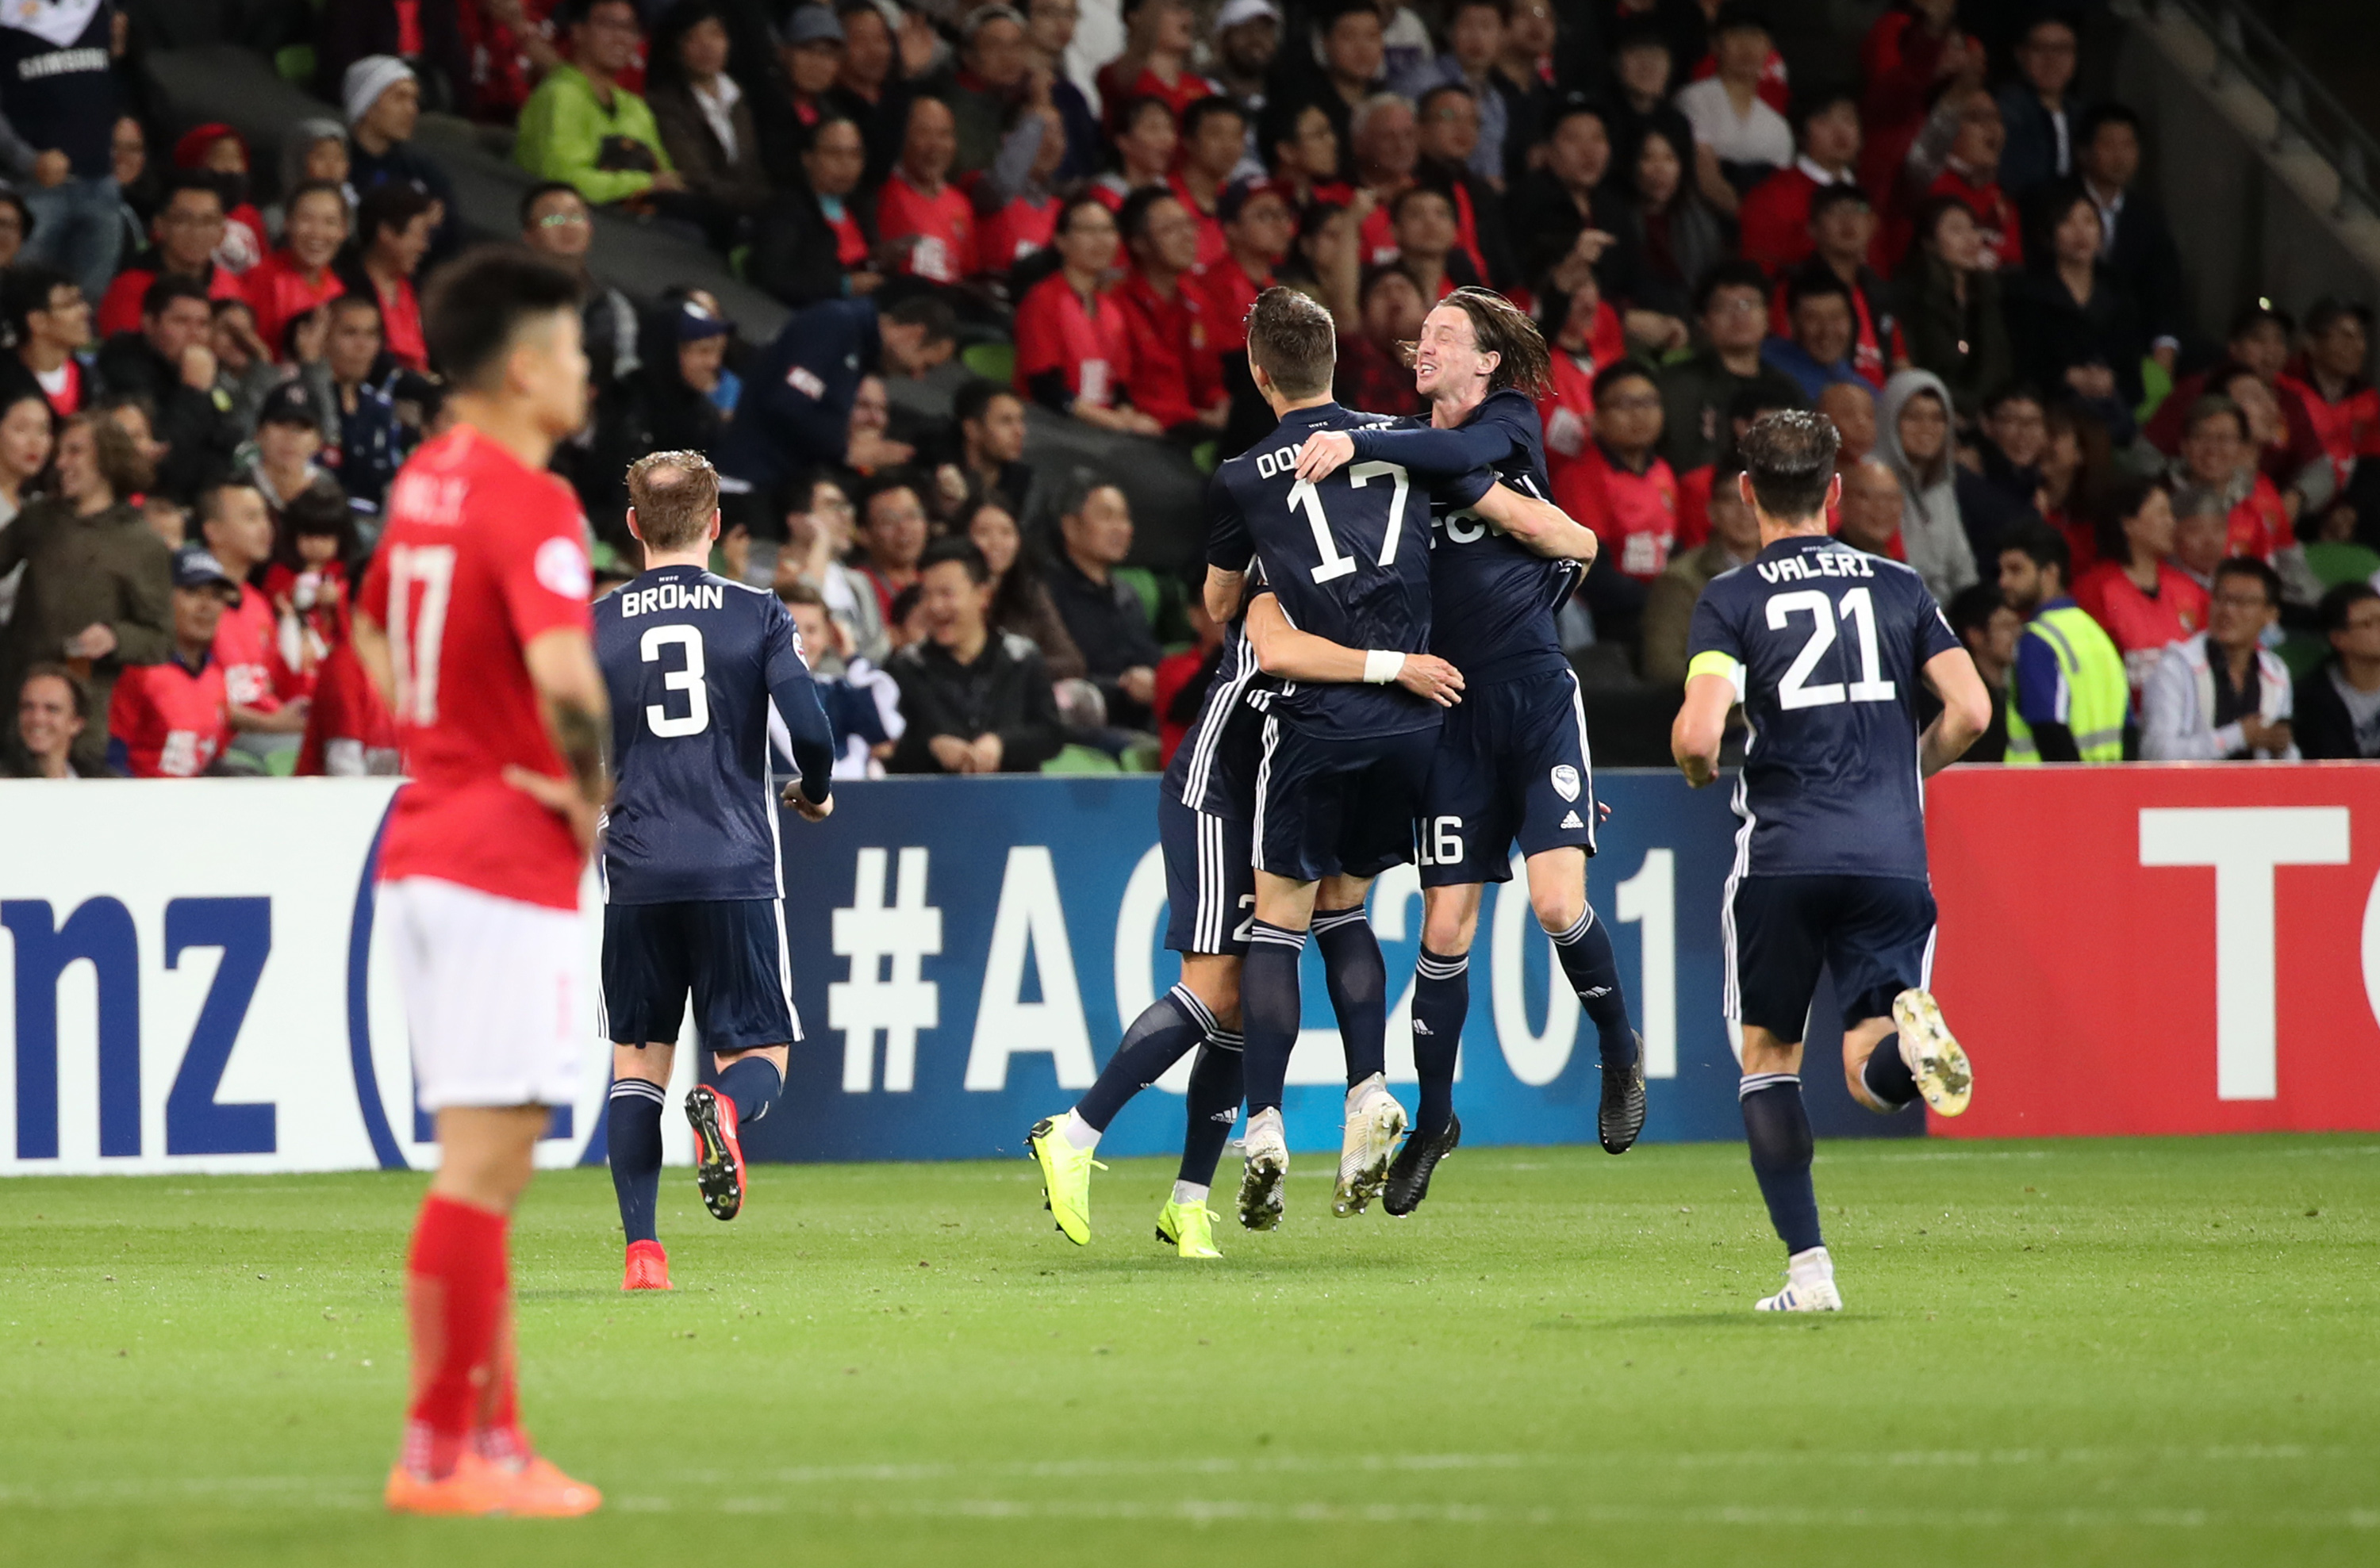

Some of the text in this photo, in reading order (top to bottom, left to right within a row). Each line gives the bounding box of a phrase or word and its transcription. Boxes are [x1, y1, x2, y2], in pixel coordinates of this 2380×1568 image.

[1287, 460, 1410, 584] 17
[1756, 553, 1875, 584] VALERI
[387, 543, 455, 728] 17
[622, 584, 724, 618] BROWN
[1765, 587, 1896, 711] 21
[639, 624, 709, 738] 3
[1419, 815, 1464, 866] 16
[2138, 806, 2380, 1101] T
